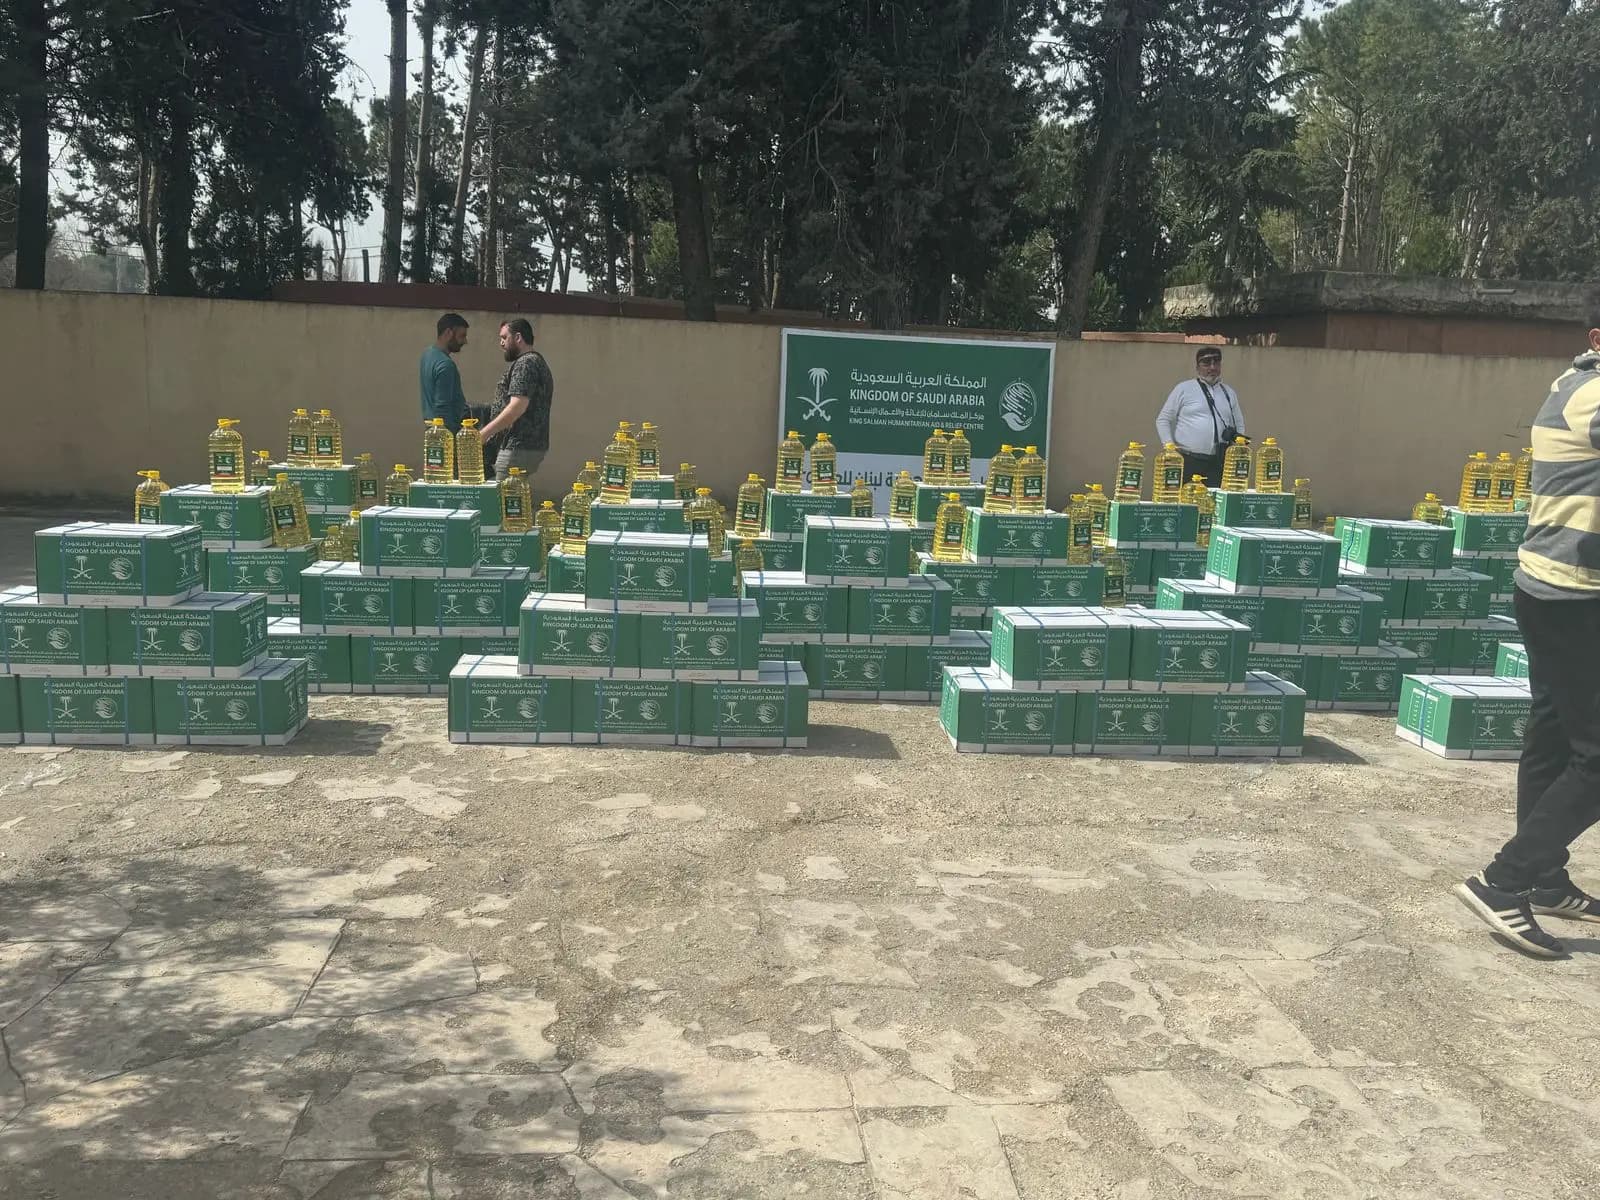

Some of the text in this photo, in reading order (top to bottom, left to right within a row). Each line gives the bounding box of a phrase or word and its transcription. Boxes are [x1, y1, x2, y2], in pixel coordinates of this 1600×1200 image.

[850, 368, 987, 389] المملكة العربية السعودية
[850, 388, 985, 406] KINGDOM OF SAUDI ARABIA
[863, 418, 887, 426] SALMAN
[888, 419, 930, 428] HUMANITARIAN
[945, 422, 962, 430] RELIEF
[963, 423, 985, 431] CENTRE
